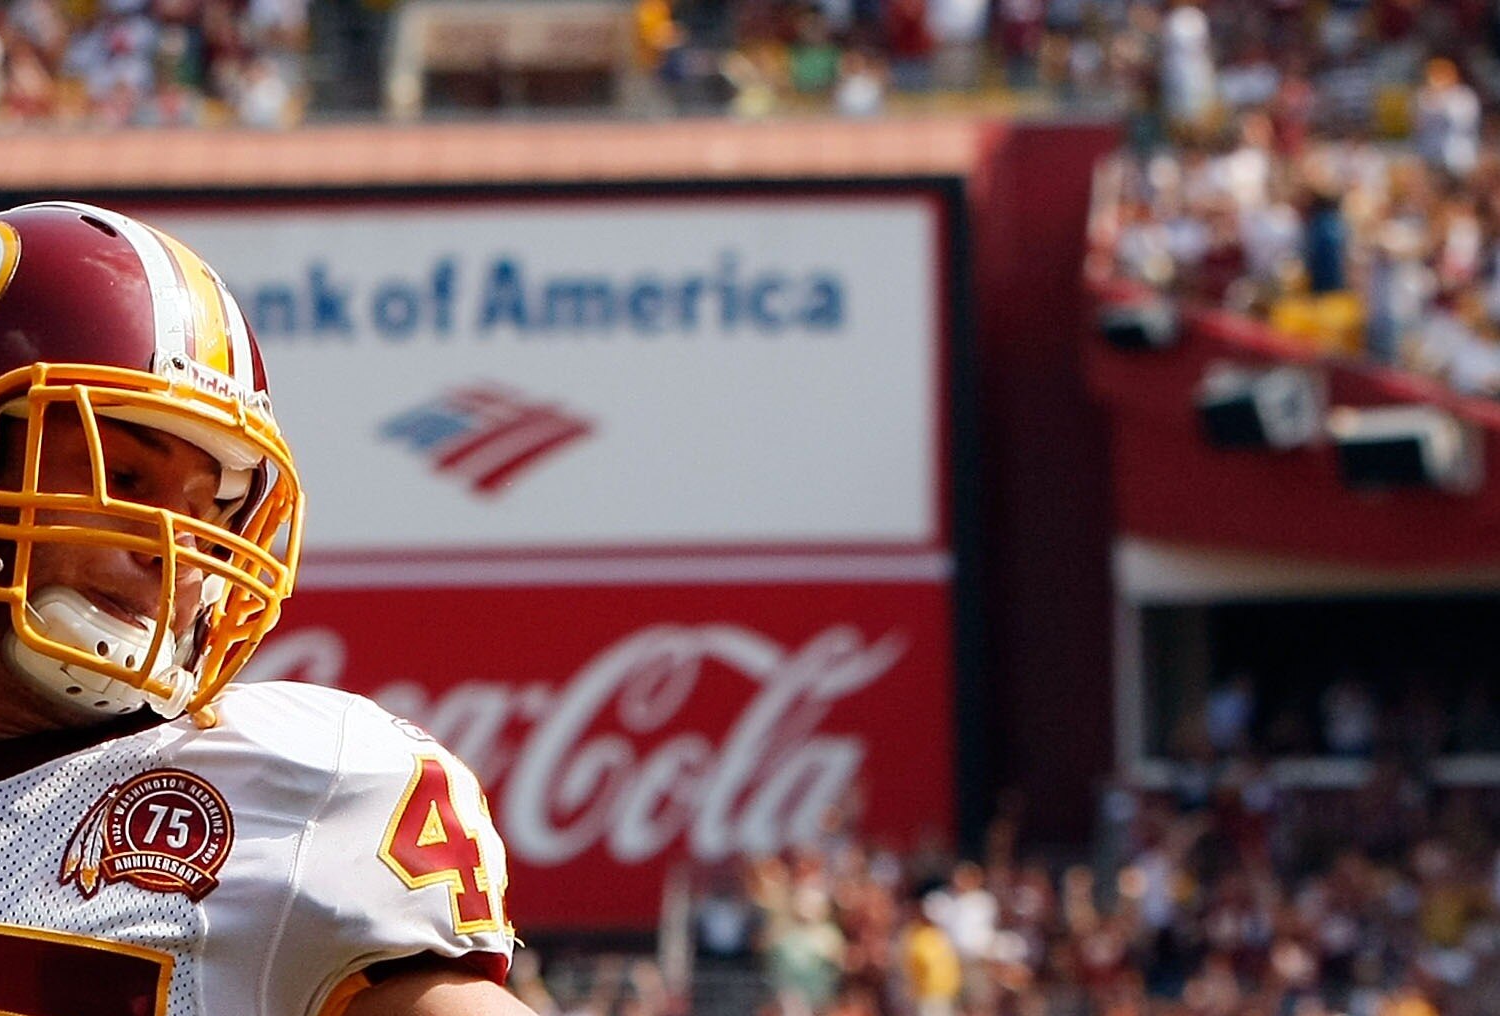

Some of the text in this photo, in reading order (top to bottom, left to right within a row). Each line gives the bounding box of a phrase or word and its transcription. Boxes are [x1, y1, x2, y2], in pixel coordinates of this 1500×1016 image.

[369, 258, 456, 336] of
[480, 256, 848, 335] America
[115, 778, 225, 836] WASHINGTON REDSKINS
[143, 803, 193, 849] 75
[114, 854, 203, 886] ANNIVERSARY
